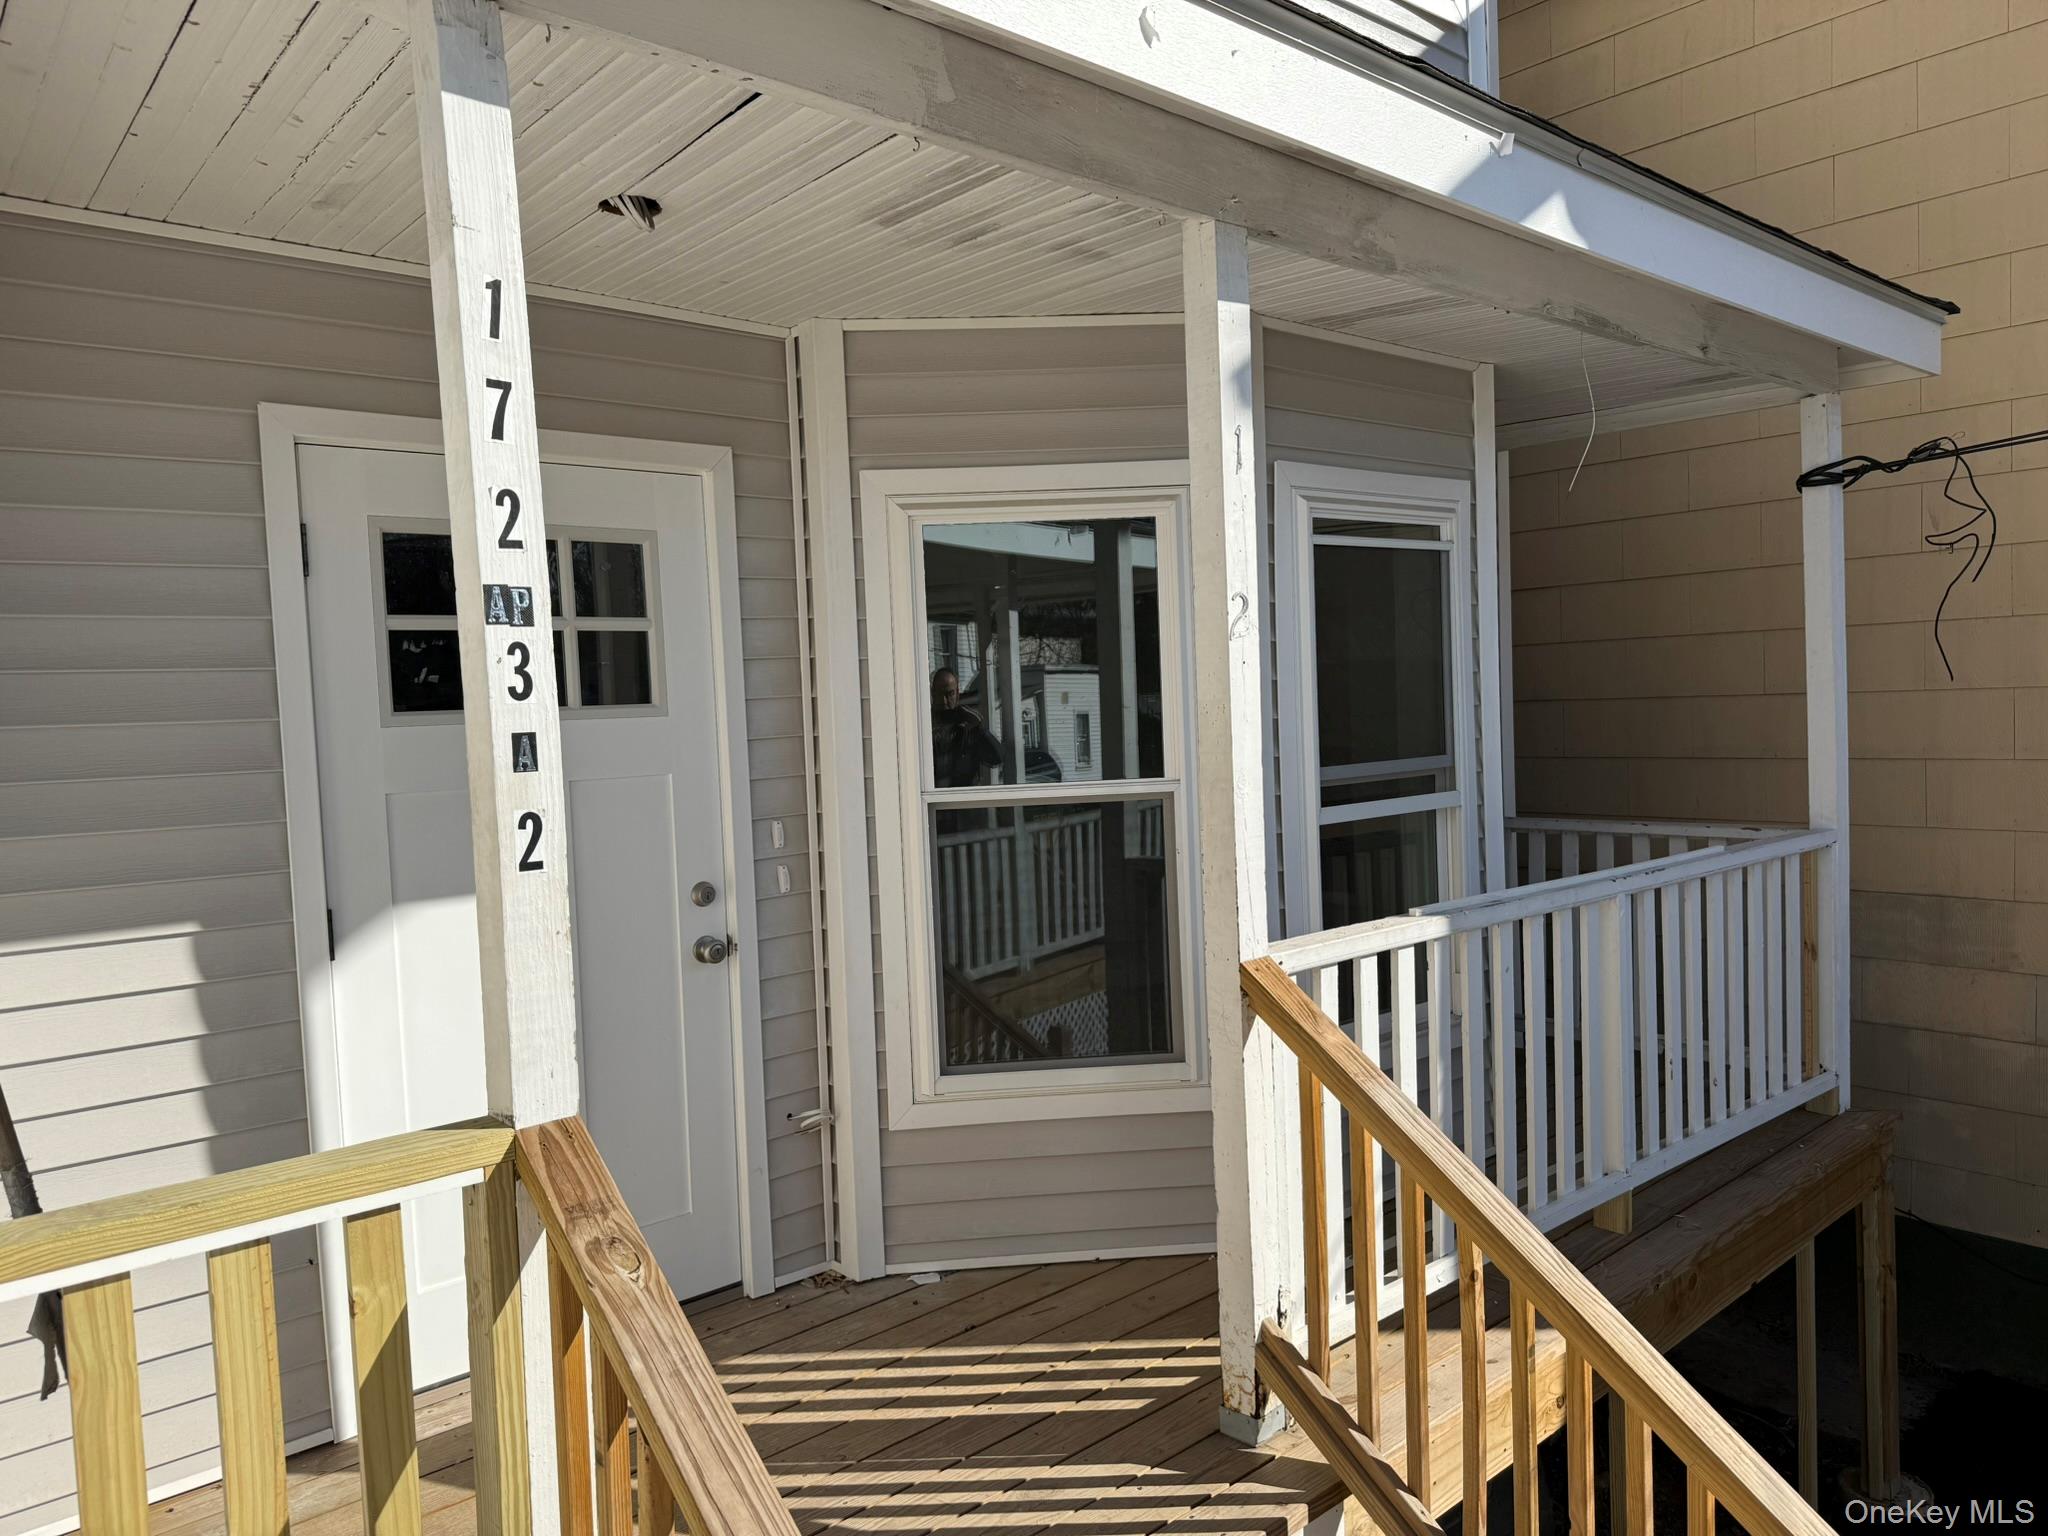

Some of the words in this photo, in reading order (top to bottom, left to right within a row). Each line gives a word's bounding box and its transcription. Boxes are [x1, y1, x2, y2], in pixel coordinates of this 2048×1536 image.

[487, 585, 532, 626] AP
[516, 734, 537, 772] A
[517, 811, 545, 872] 2
